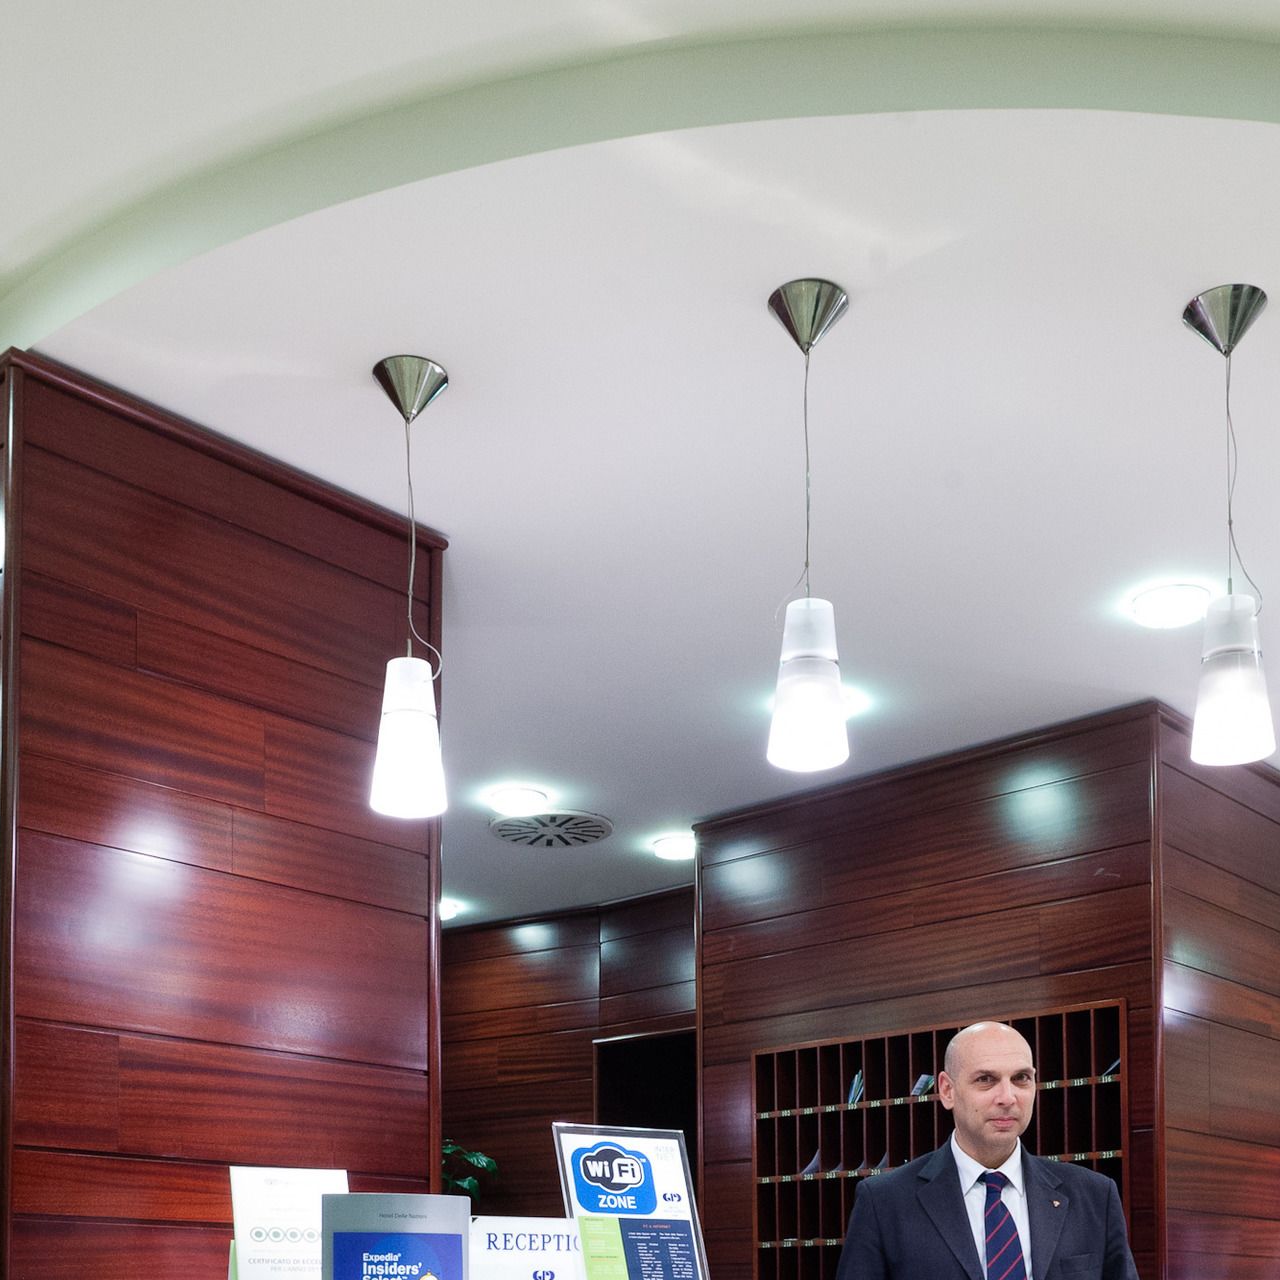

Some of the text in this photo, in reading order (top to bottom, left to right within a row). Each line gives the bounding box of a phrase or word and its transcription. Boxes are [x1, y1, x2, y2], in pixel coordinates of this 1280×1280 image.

[825, 1105, 835, 1113] 104
[870, 1100, 880, 1108] 106
[1074, 1153, 1085, 1161] 214
[597, 1194, 638, 1209] ZONE
